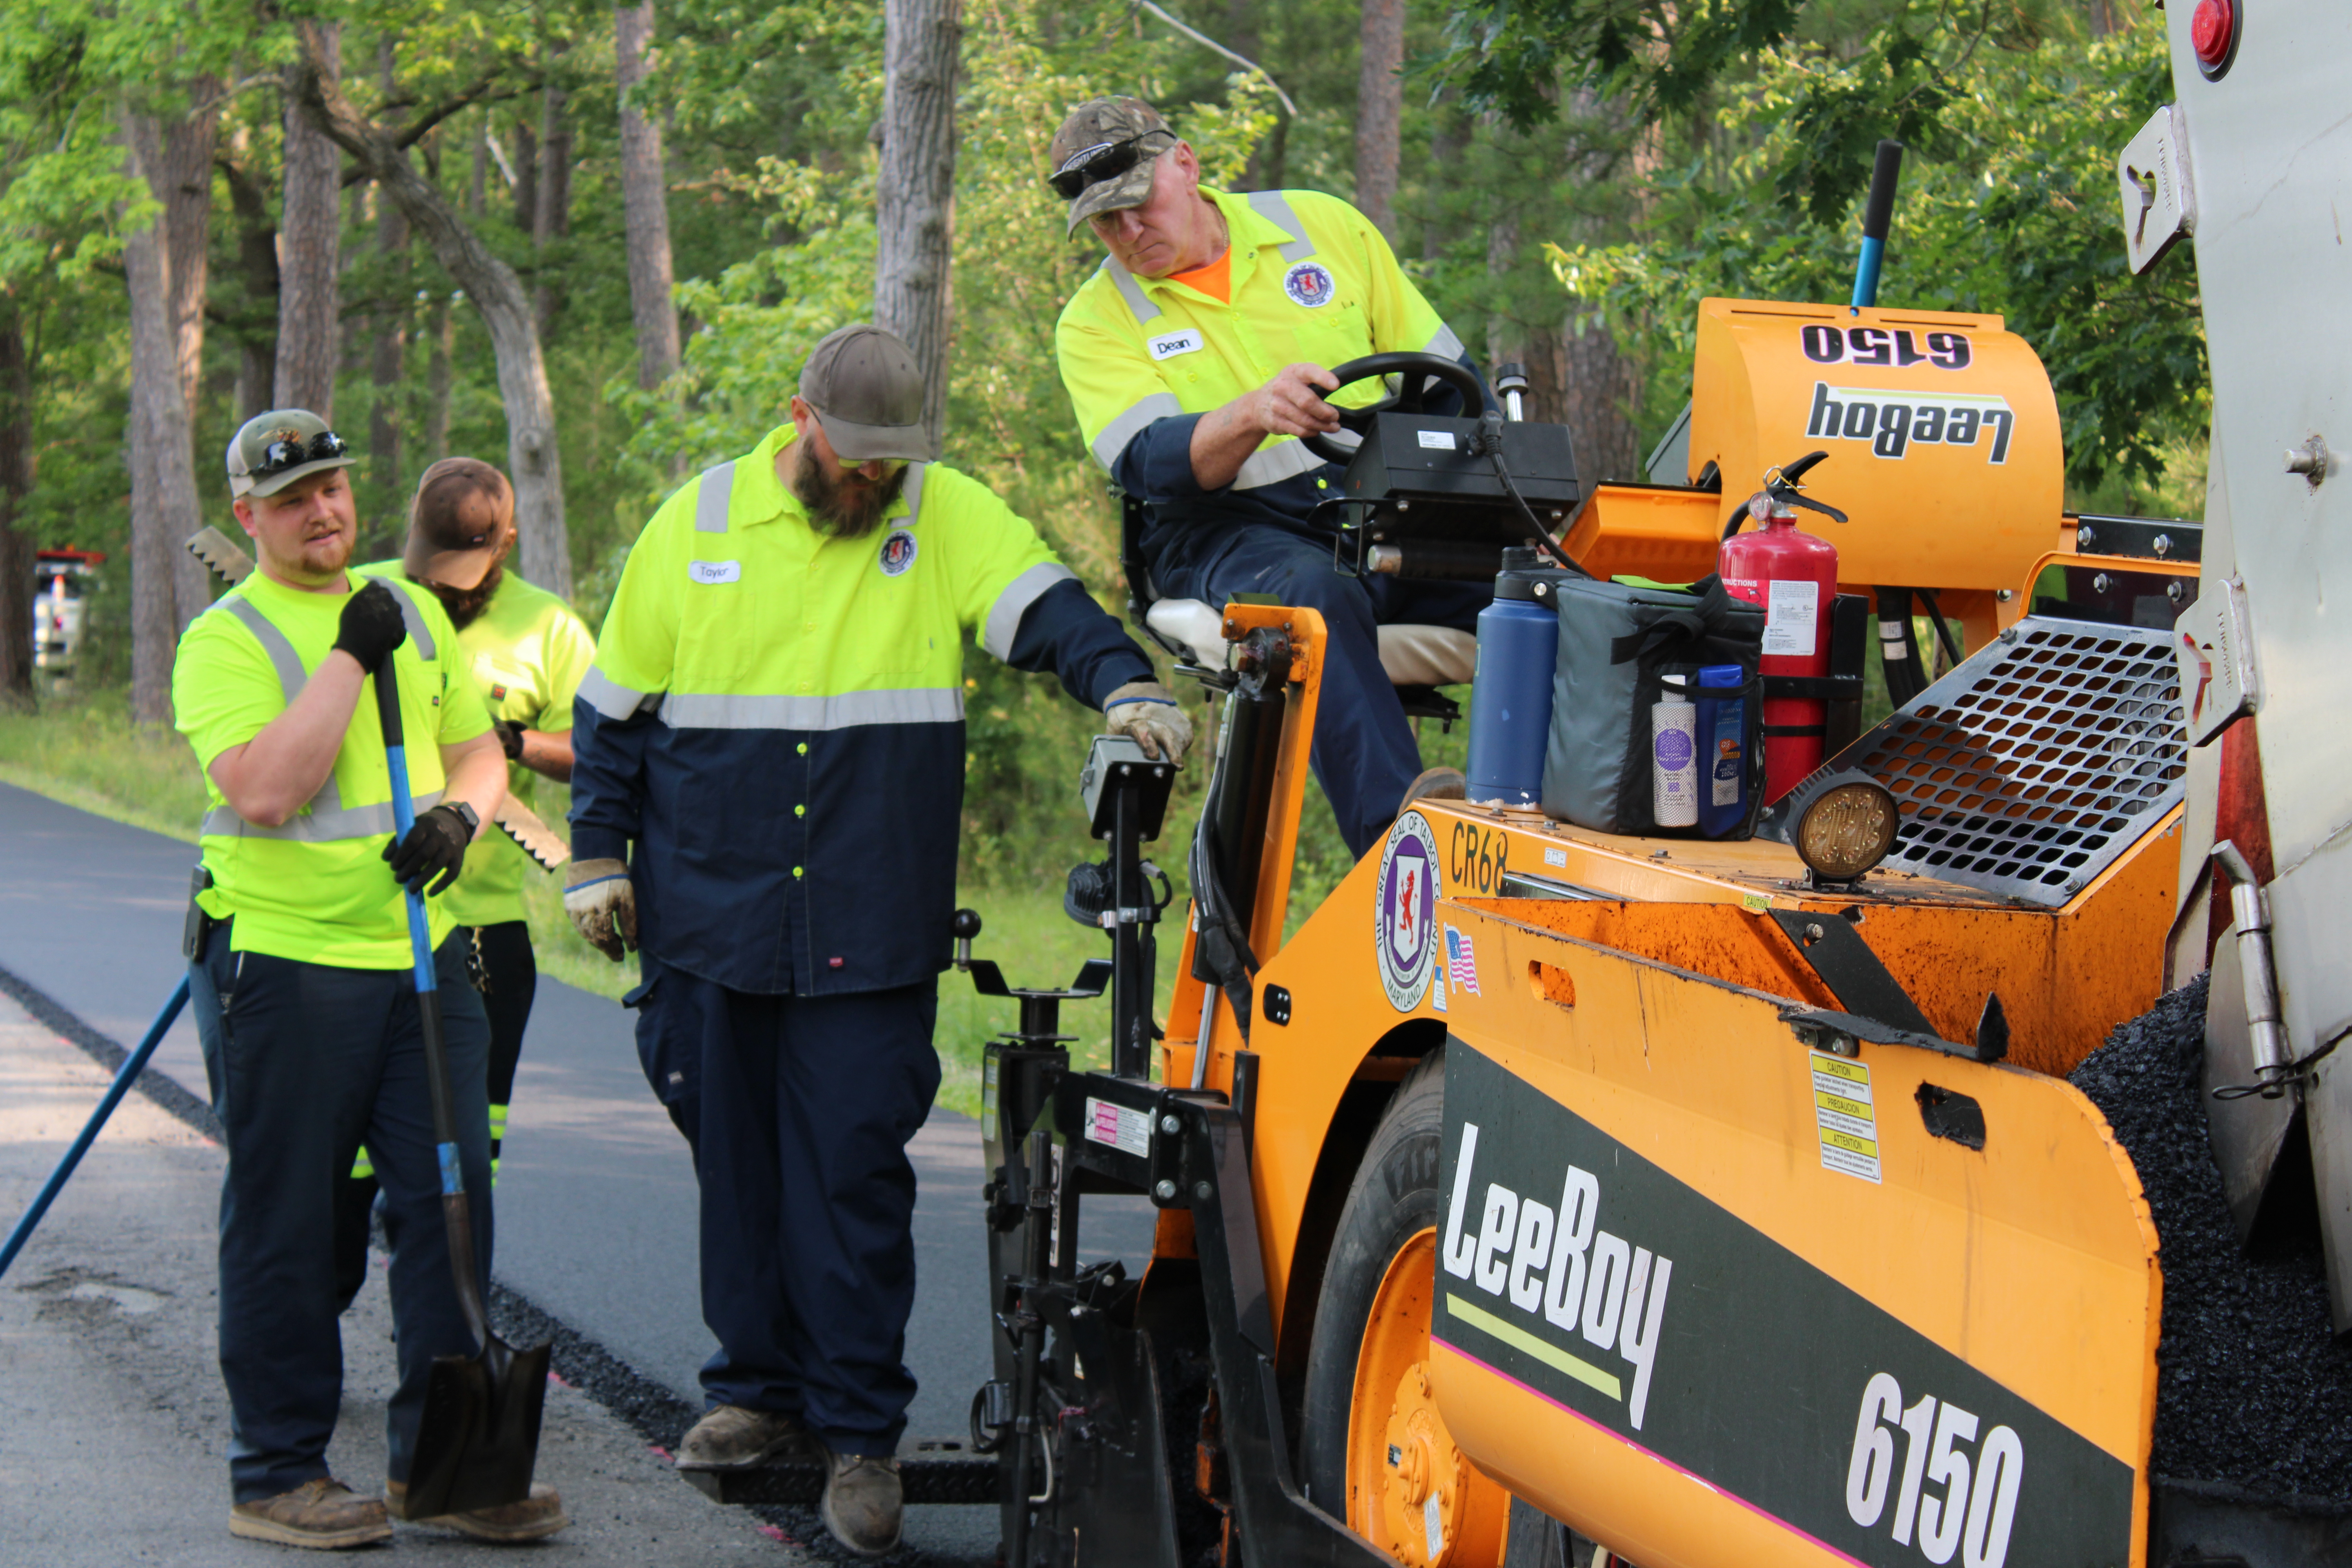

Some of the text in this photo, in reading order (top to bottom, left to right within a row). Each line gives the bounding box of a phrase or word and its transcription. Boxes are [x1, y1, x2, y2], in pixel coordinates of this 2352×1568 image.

[1157, 339, 1191, 354] Dean
[1801, 325, 1971, 369] 6150
[1806, 382, 2013, 464] LeeBoy
[700, 566, 728, 578] Taylor
[1721, 578, 1757, 587] STRUCTIONS
[1451, 821, 1508, 897] CR68
[1377, 850, 1390, 906] GREAT
[1390, 819, 1405, 849] SEAL
[1408, 815, 1417, 831] OF
[1419, 821, 1438, 872] TALBOT
[1430, 883, 1440, 961] CNTY
[1746, 896, 1768, 909] CAUTION
[1387, 978, 1421, 1007] MARYLAND
[1827, 1062, 1851, 1076] CAUTION
[1827, 1097, 1860, 1114] PRECAUCION
[1833, 1133, 1862, 1151] ATTENTION
[1443, 1122, 1672, 1431] LeeBoy
[1846, 1372, 2023, 1568] 6150
